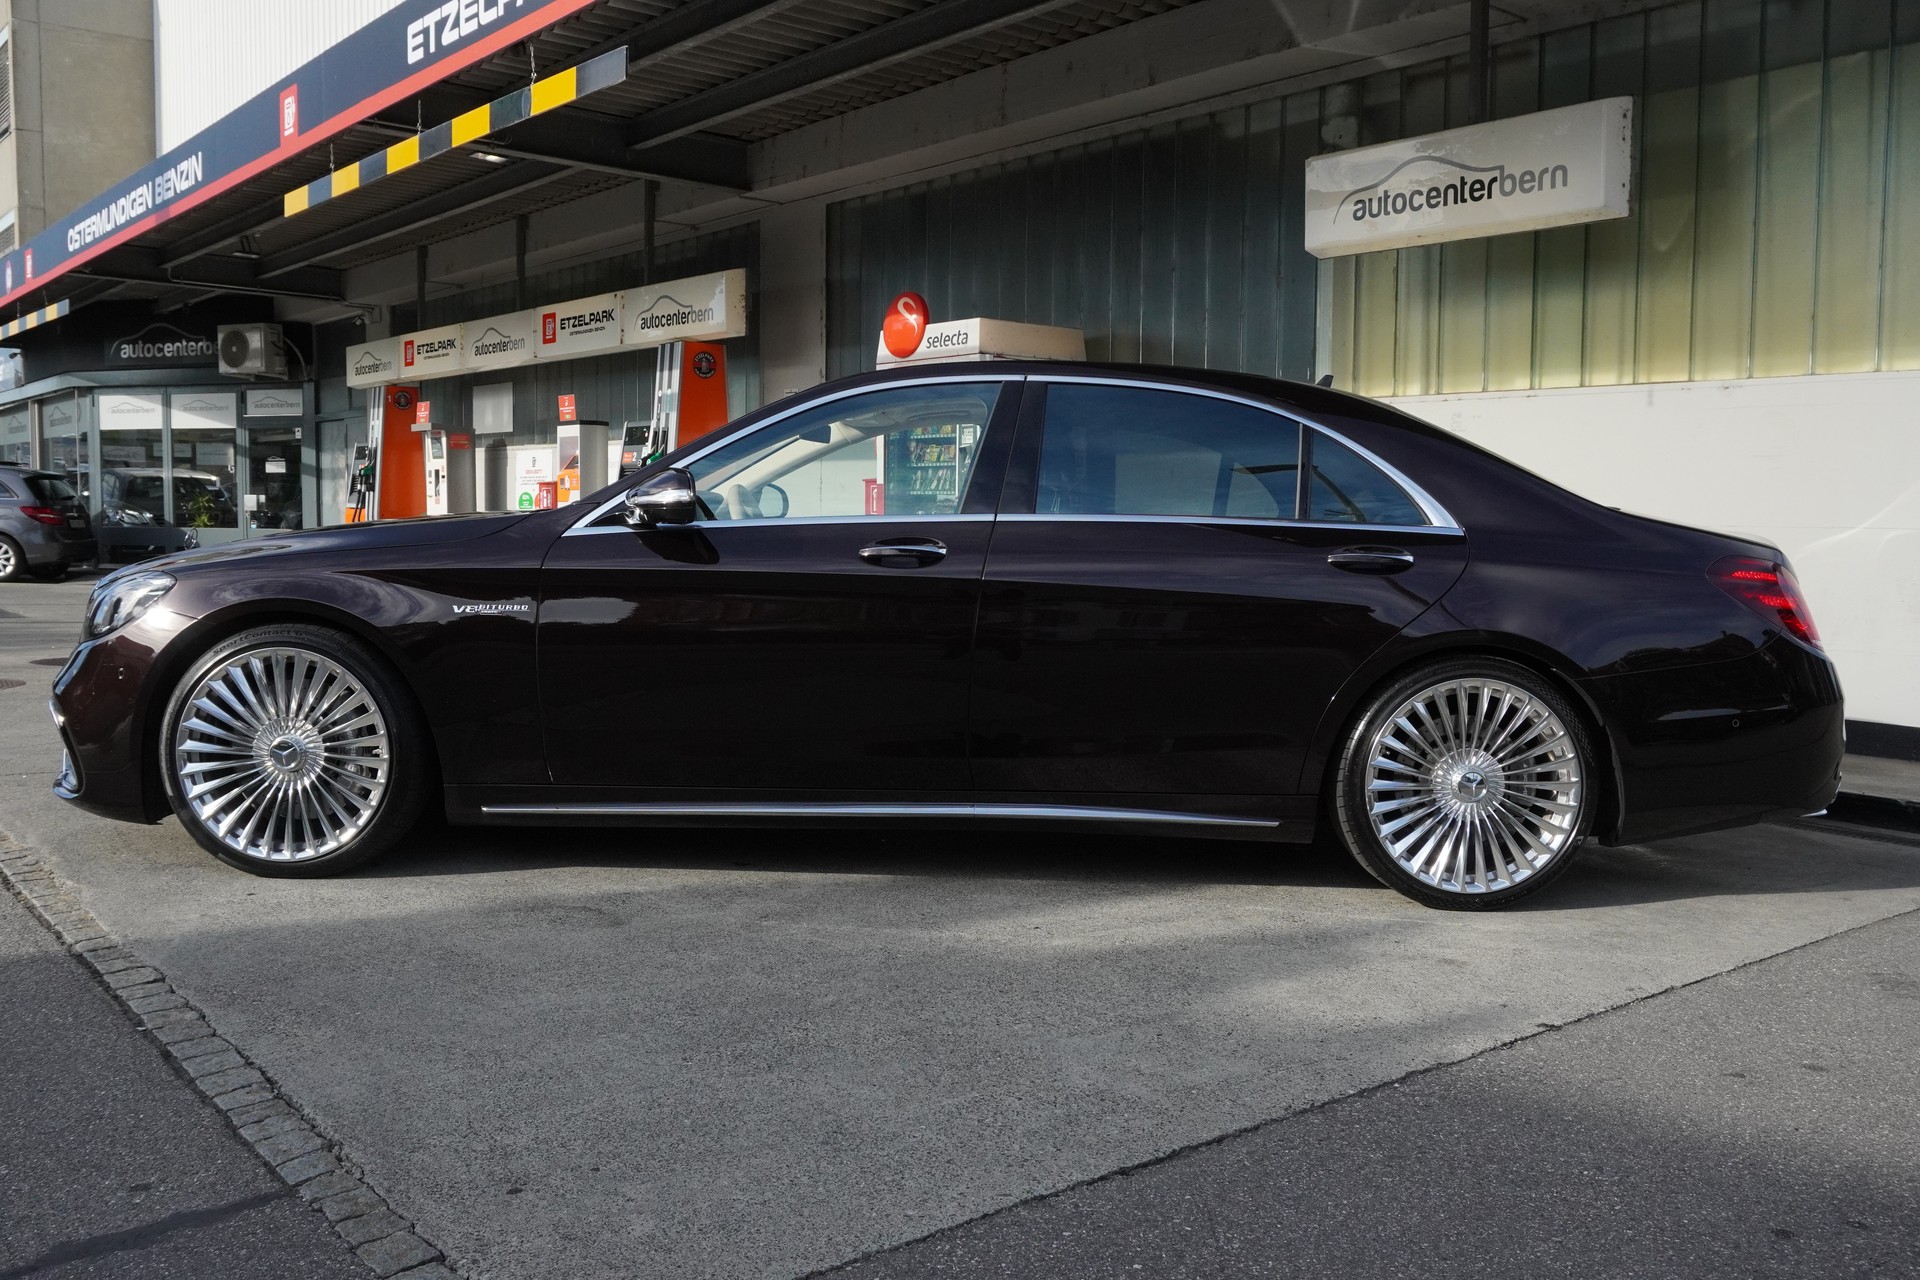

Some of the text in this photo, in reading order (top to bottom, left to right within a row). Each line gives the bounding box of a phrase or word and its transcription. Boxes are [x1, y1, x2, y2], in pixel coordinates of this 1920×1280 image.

[67, 151, 202, 252] OSTERMUNDIGEN BENZIN
[1353, 164, 1568, 221] autocenterbern
[560, 309, 615, 330] ETZELPARK
[640, 305, 714, 330] autocenterbern
[416, 338, 457, 355] ETZELPARK
[474, 336, 526, 357] autocenterbern
[926, 330, 969, 349] selecta
[354, 360, 392, 376] autocenterbern
[632, 452, 637, 462] 2
